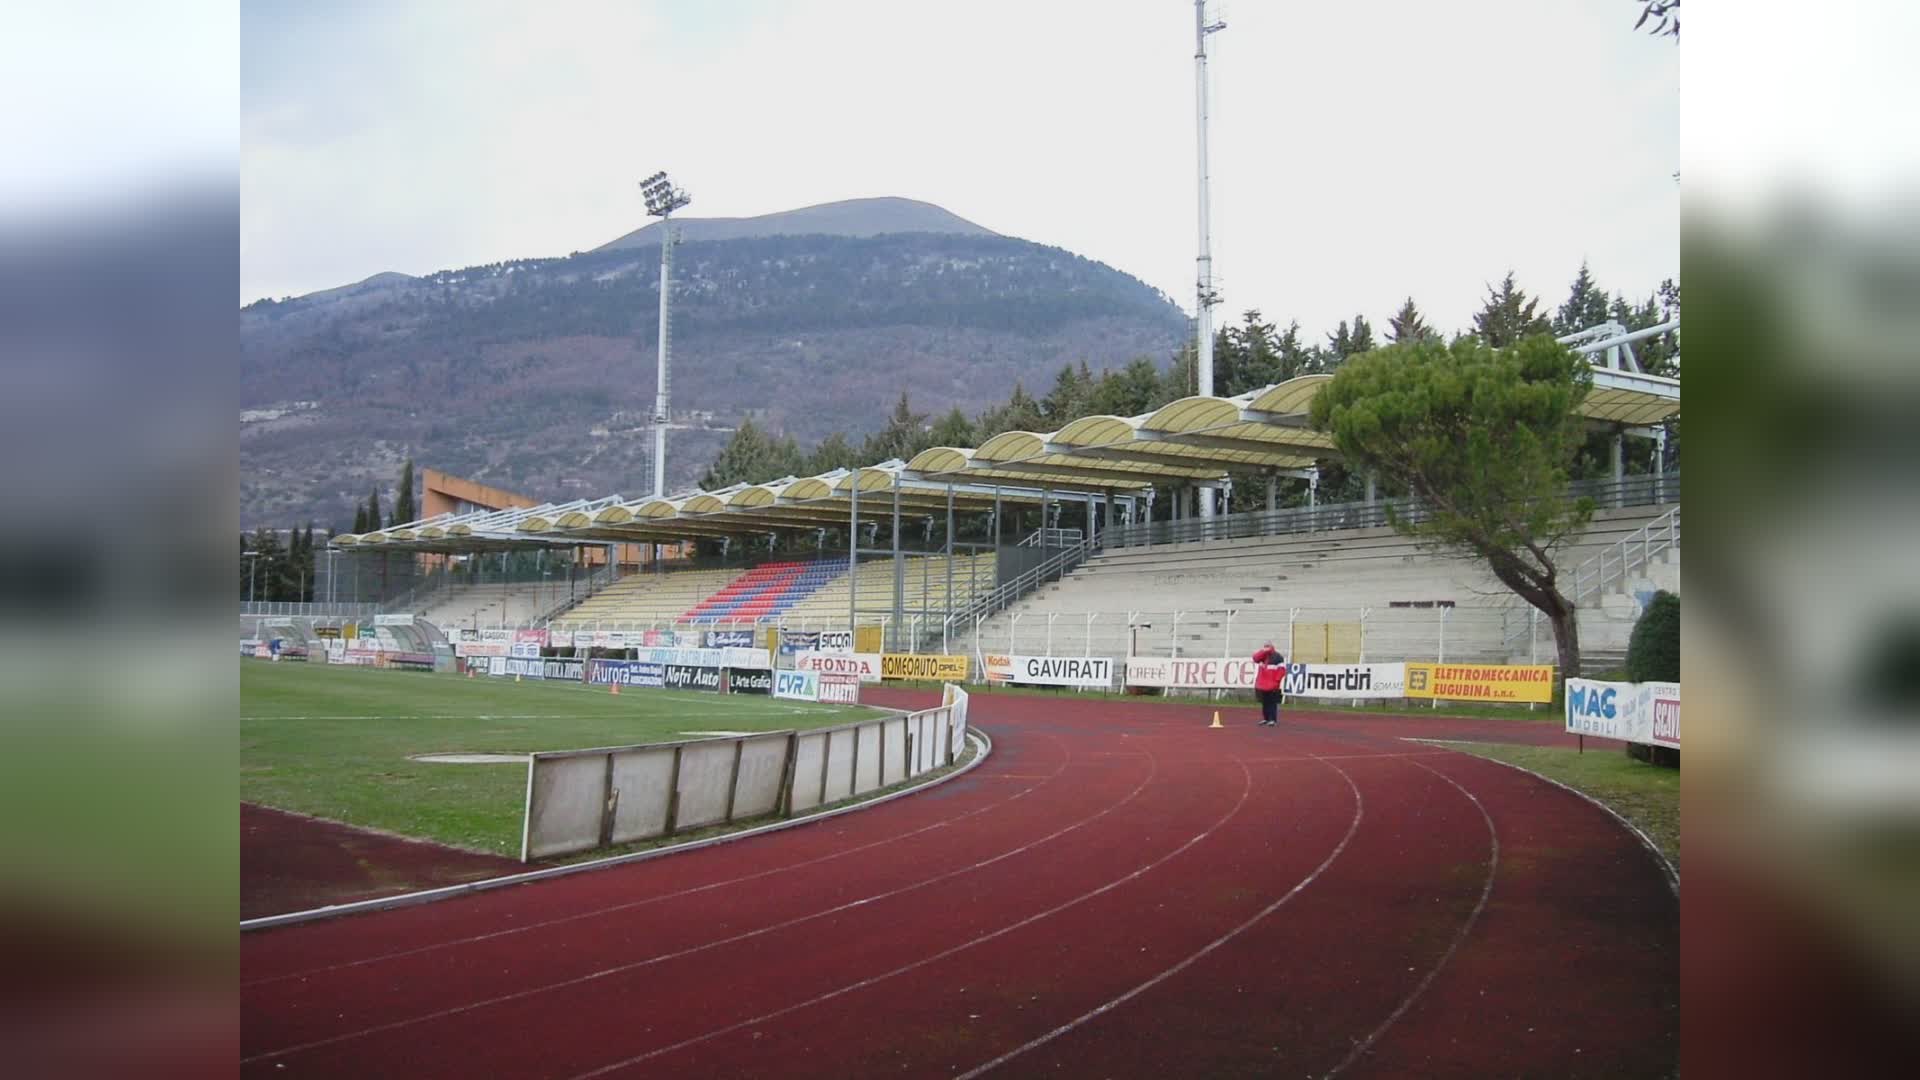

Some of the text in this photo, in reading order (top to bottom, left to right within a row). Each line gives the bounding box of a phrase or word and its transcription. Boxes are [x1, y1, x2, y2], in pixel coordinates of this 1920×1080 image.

[812, 658, 871, 674] HONDA
[882, 656, 937, 676] ROMEOAUTO
[939, 664, 958, 672] OPEL
[988, 655, 1011, 667] Kodak
[1027, 659, 1108, 679] GAVIRATI
[592, 663, 629, 684] Aurora
[665, 665, 719, 687] Nofri Auto
[1171, 661, 1217, 684] TRE
[1434, 668, 1548, 683] ELETTROMECCANICA
[778, 674, 804, 694] CVR
[1433, 684, 1491, 698] EUGUBINA
[1568, 684, 1616, 727] MAG
[1574, 718, 1616, 735] MOBILI
